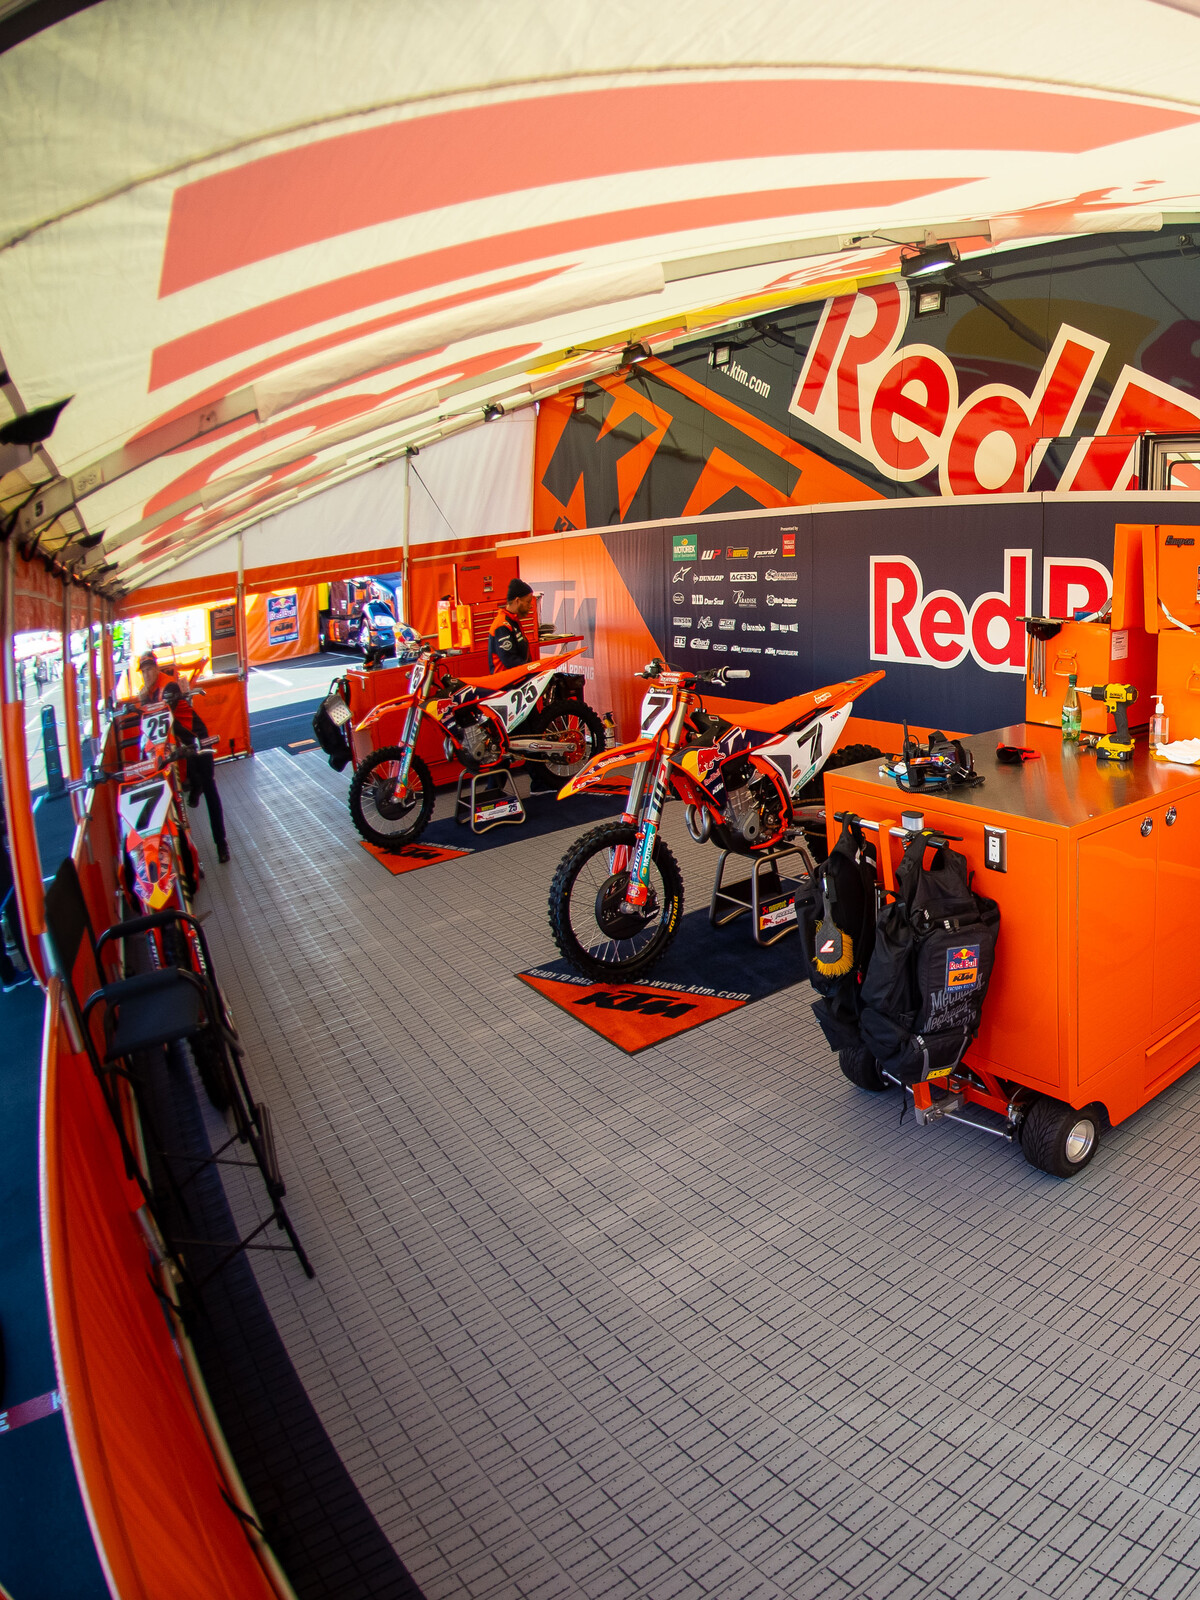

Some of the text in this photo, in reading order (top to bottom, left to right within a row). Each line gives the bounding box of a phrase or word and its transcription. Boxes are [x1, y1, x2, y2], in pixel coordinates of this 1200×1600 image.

[674, 545, 696, 554] MOTOREX
[701, 550, 721, 560] WP
[870, 549, 1032, 675] Red
[747, 623, 766, 632] brembo
[510, 681, 538, 716] 25
[642, 696, 671, 731] 7
[147, 713, 169, 742] 25
[797, 721, 823, 767] 7
[129, 784, 165, 832] 7
[643, 832, 656, 868] MOTOREX
[668, 895, 679, 933] DUNLOP
[529, 969, 559, 980] READY
[561, 973, 568, 983] TO
[650, 979, 751, 1001] www.ktm.com
[952, 972, 973, 982] KTM
[571, 989, 700, 1019] KTM
